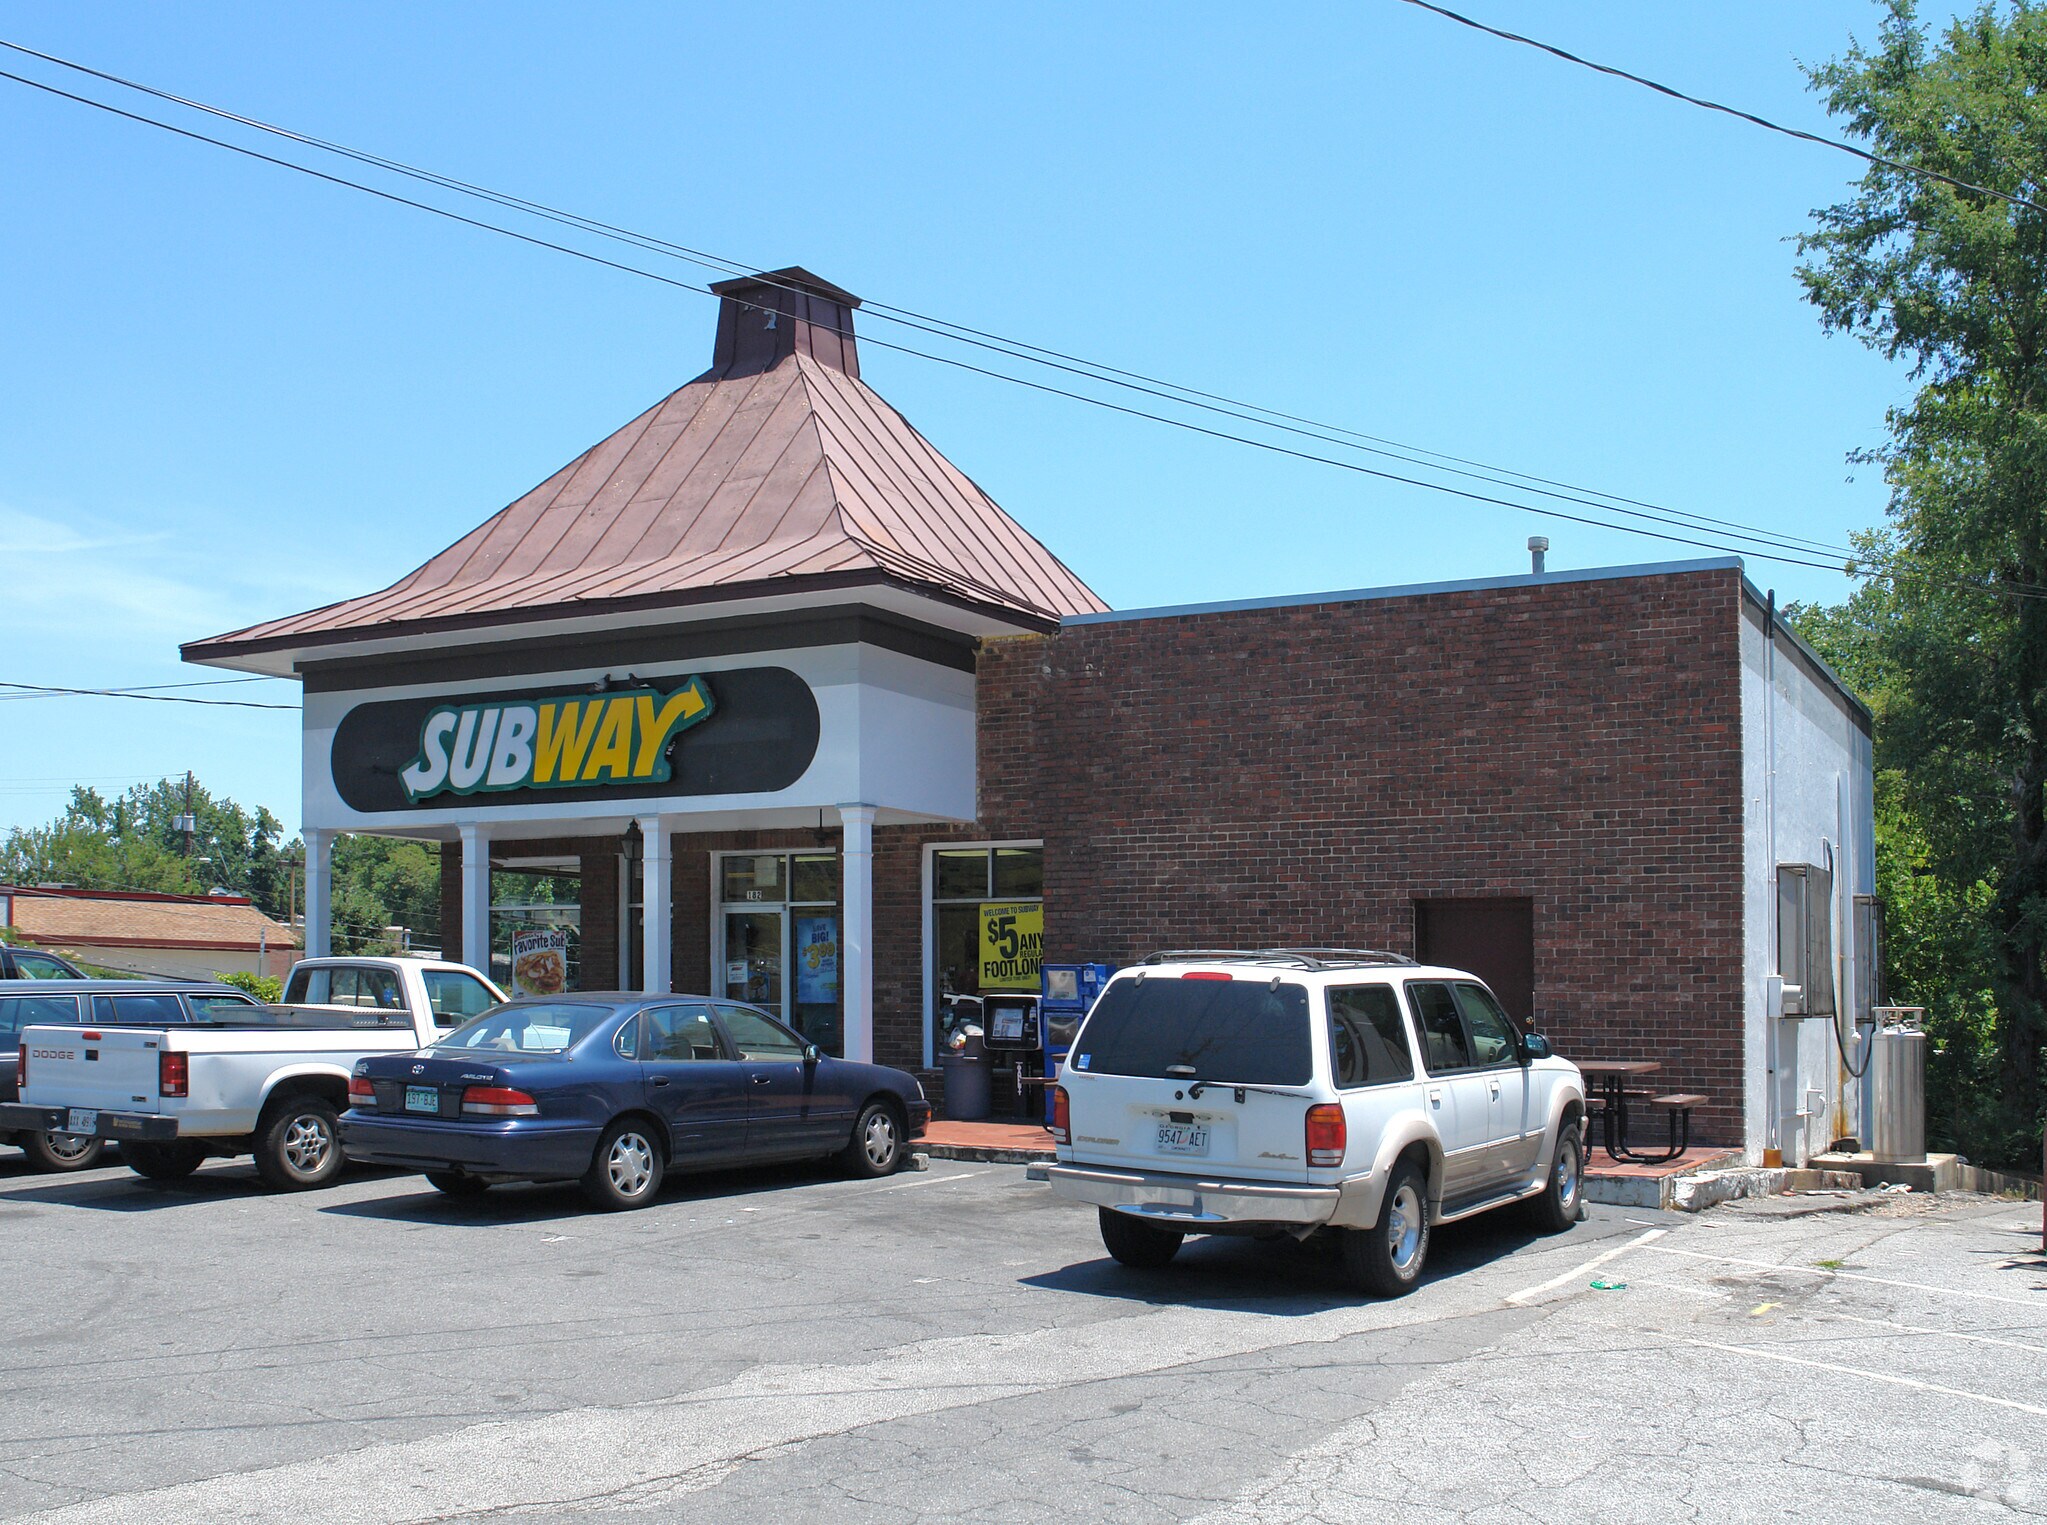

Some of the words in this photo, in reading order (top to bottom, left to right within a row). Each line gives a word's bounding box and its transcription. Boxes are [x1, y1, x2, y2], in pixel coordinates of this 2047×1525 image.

[401, 683, 706, 797] SUBWAY
[748, 891, 761, 899] 182
[984, 907, 1009, 917] WELCOME
[1010, 906, 1018, 914] TO
[1018, 904, 1039, 914] SUBWAY
[514, 934, 549, 955] Favorite
[987, 915, 1019, 959] $5
[1020, 932, 1044, 950] ANY
[1020, 949, 1044, 958] REGULA
[33, 1050, 74, 1060] DODGE
[1158, 1129, 1182, 1145] 9547
[1188, 1132, 1207, 1147] AET
